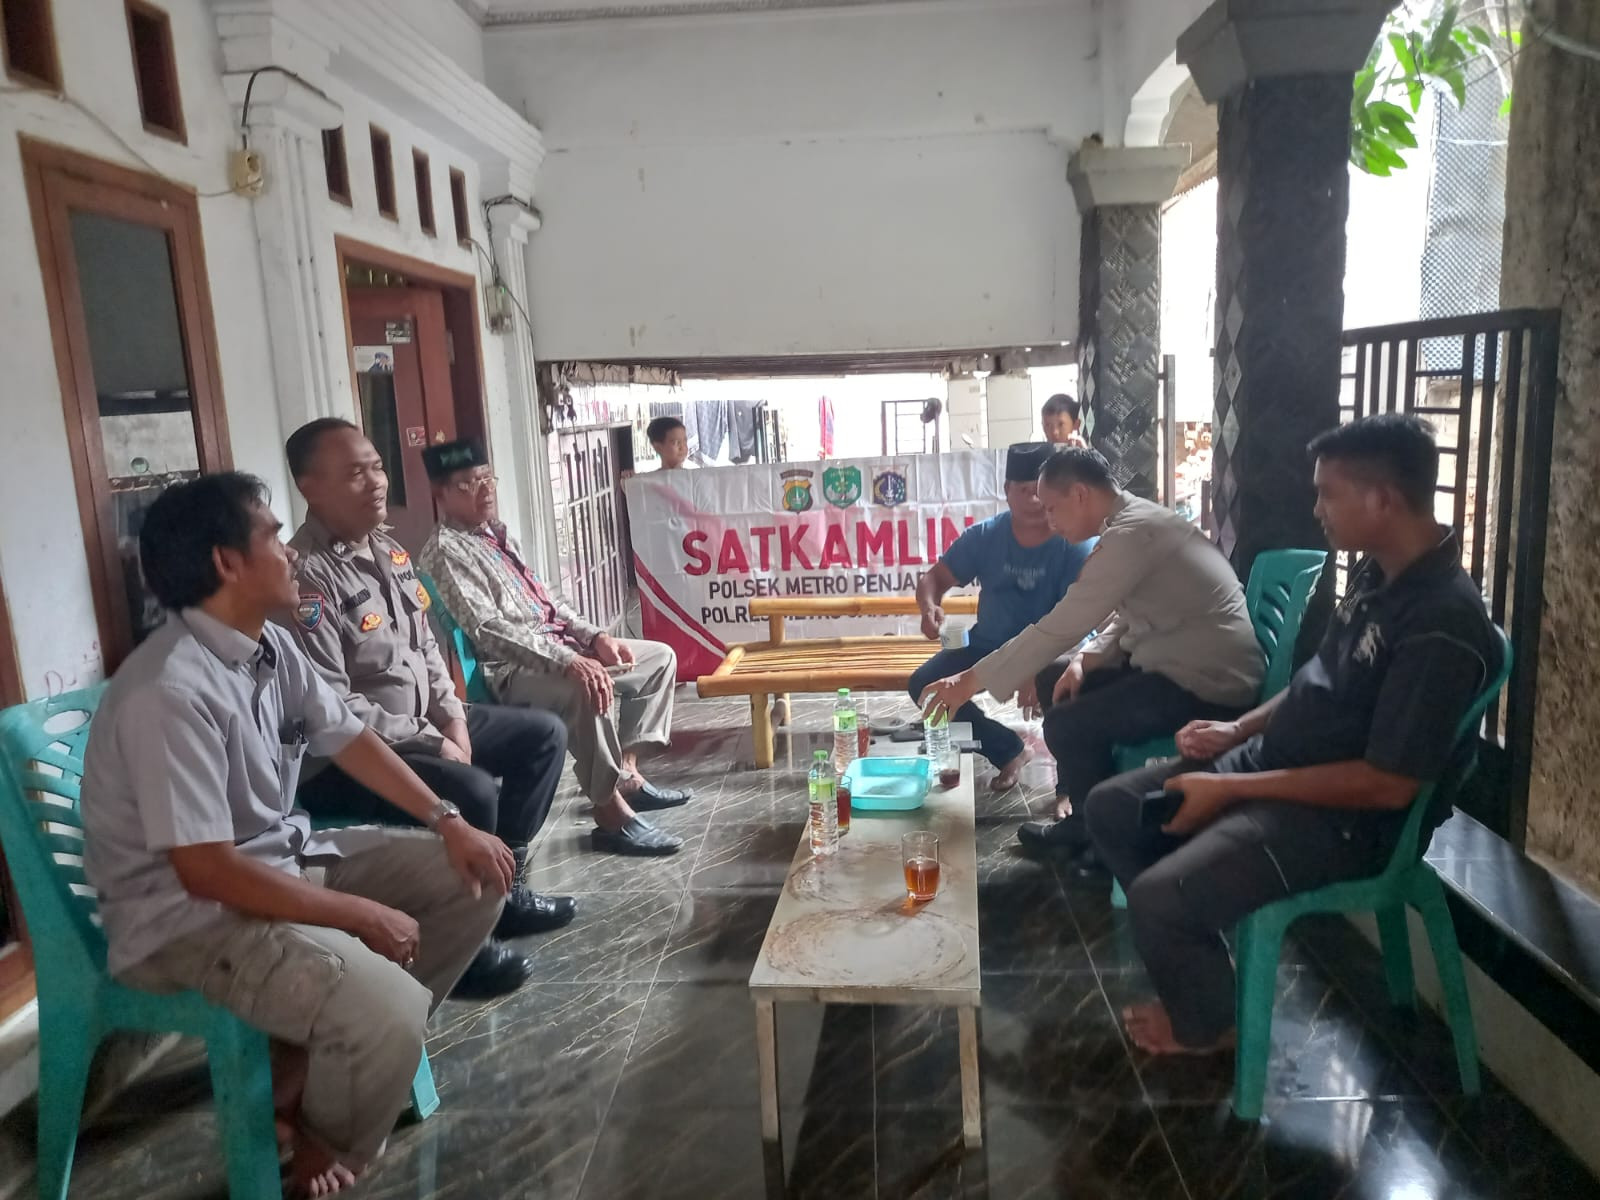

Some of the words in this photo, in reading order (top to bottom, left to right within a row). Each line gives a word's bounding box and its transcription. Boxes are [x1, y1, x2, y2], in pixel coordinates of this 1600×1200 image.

[709, 577, 780, 600] POLSEK
[785, 575, 848, 595] METRO
[854, 571, 927, 593] PENJA
[701, 606, 770, 624] POLR
